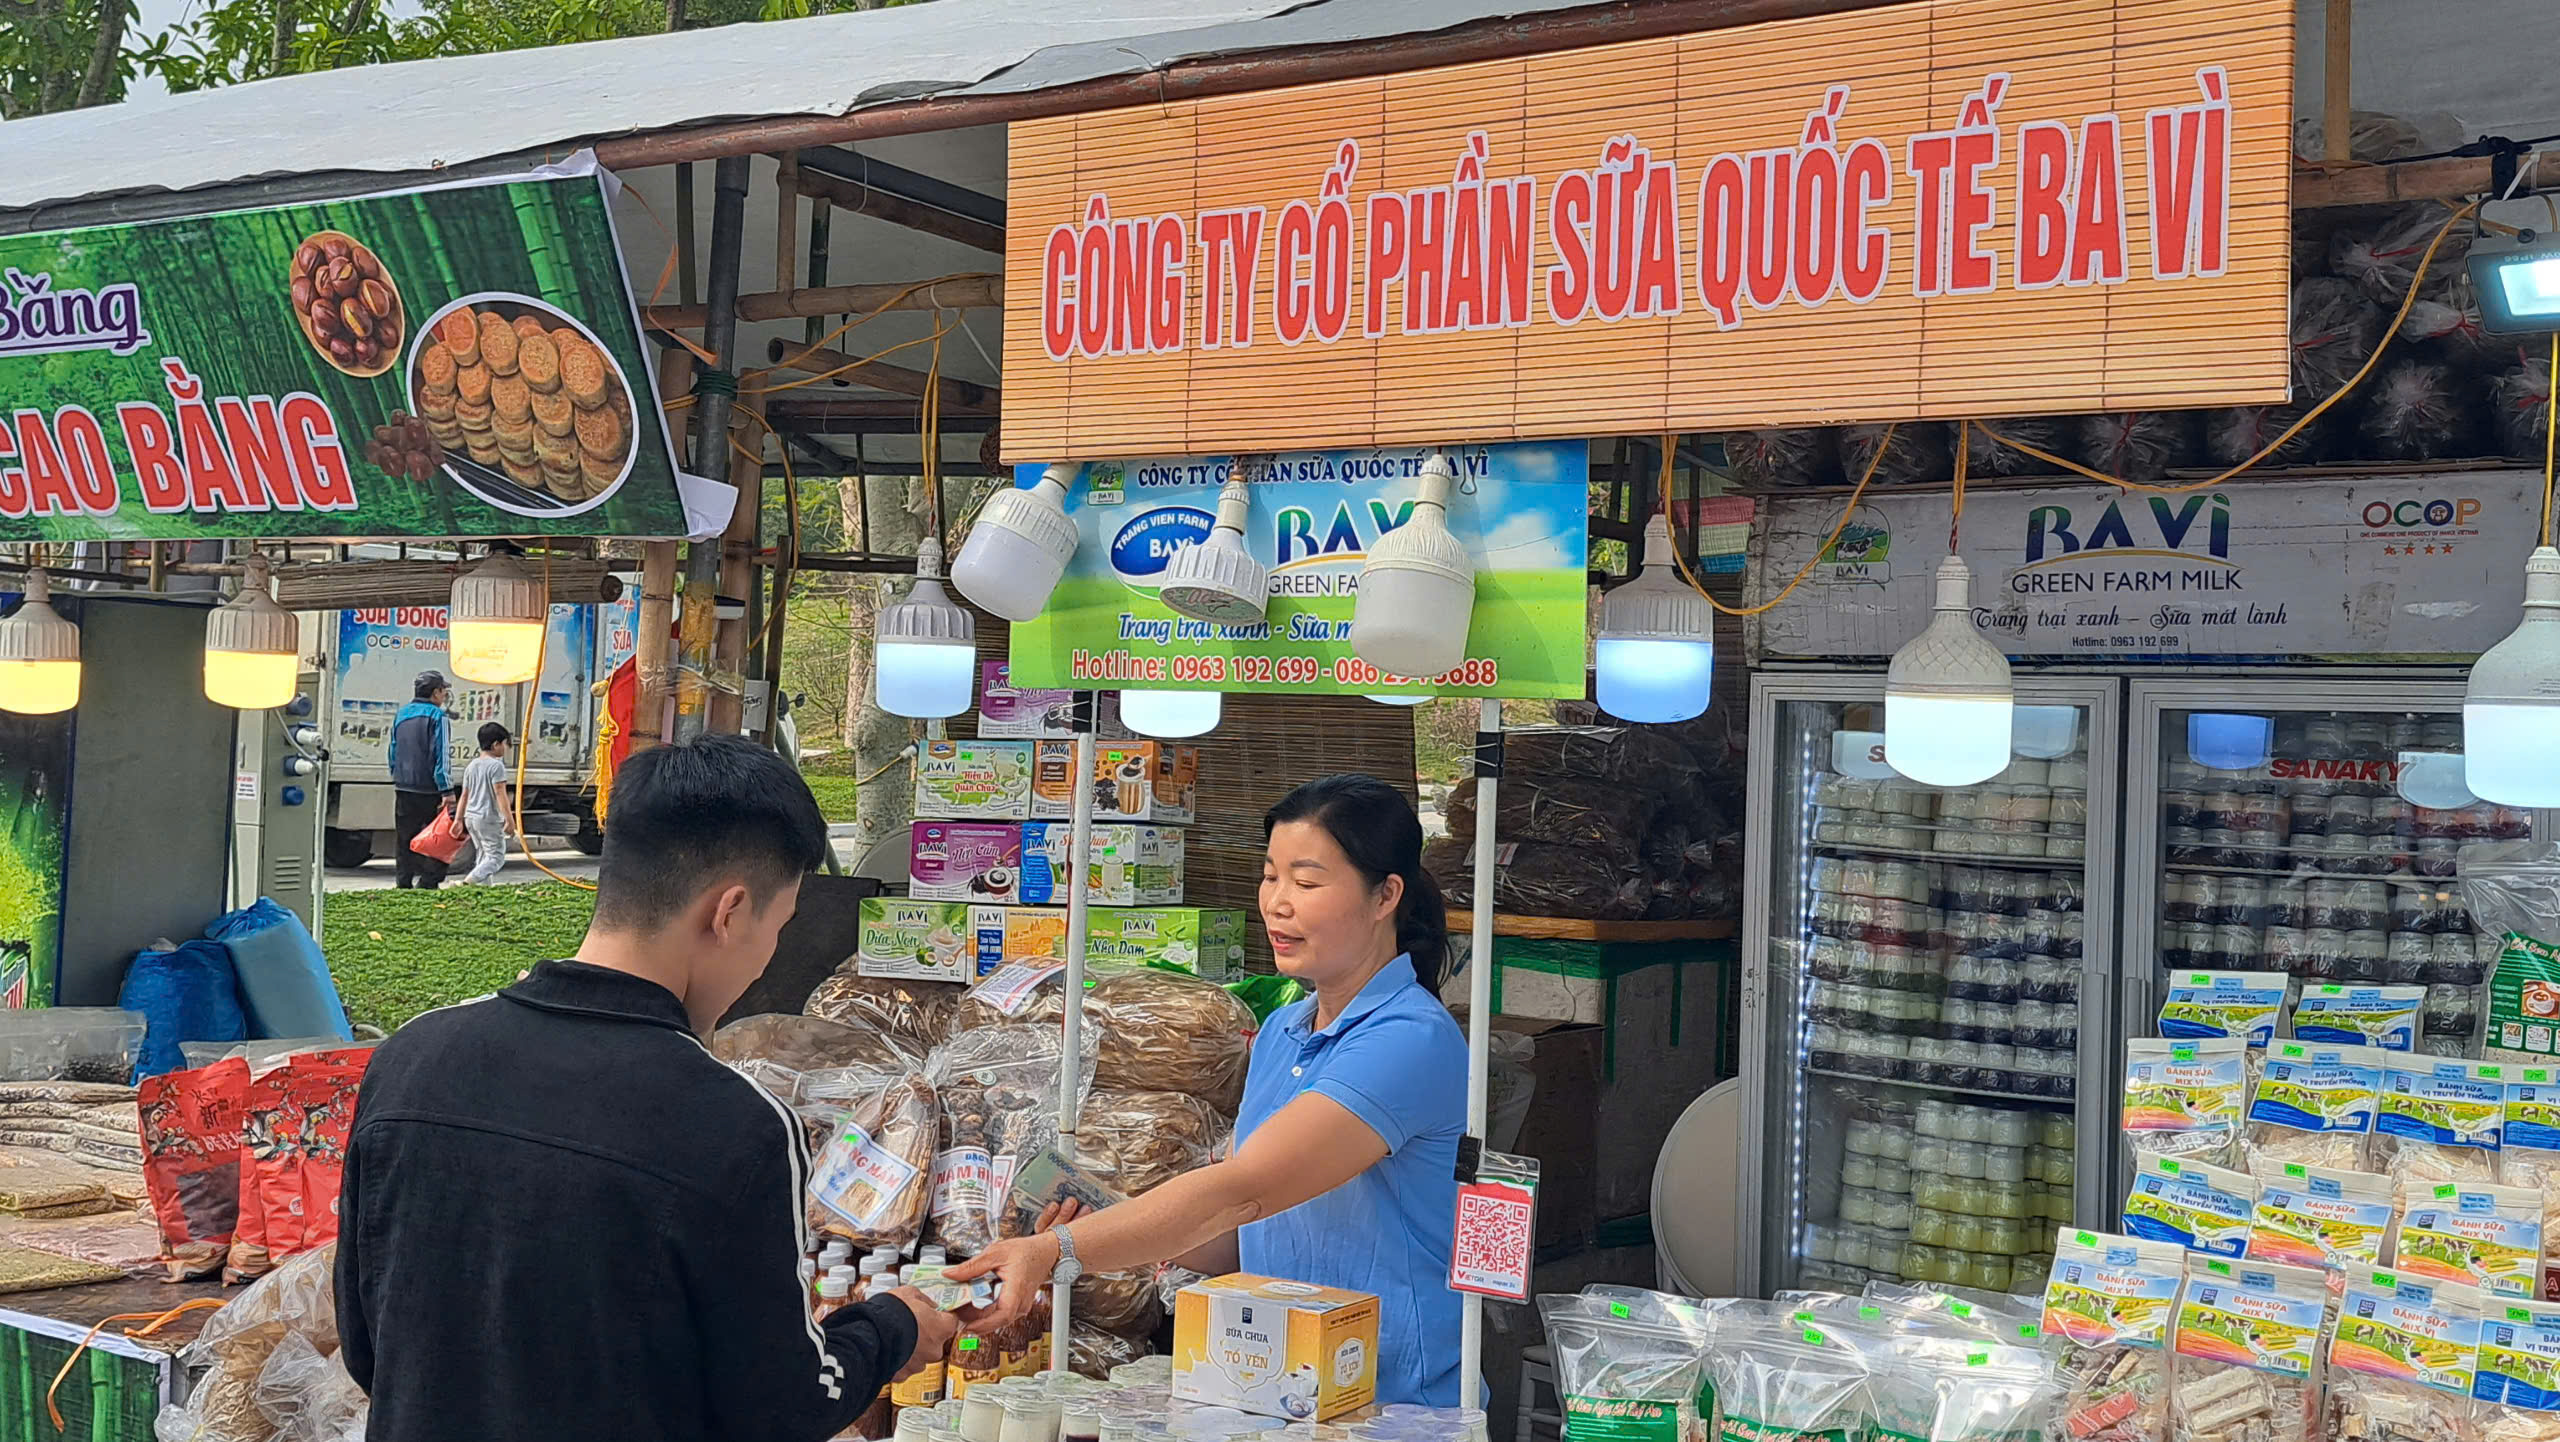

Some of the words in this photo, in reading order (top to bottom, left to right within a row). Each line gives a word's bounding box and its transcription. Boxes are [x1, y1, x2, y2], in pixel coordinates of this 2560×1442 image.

[1043, 194, 1186, 361] CÔNG
[1197, 206, 1266, 349] TY
[1275, 138, 1360, 345] CỔ
[1364, 131, 1536, 338] PHẦN
[1547, 133, 1682, 326] SỮA
[1701, 86, 1892, 331] QUỐC
[1908, 72, 2010, 297] TẾ
[2016, 114, 2127, 291] BA
[2145, 66, 2232, 280] VÌ
[0, 270, 139, 352] Bằng
[0, 404, 120, 519] CAO
[118, 357, 357, 513] BẰNG
[1138, 462, 1183, 486] CÔNG
[1187, 465, 1211, 485] TY
[1297, 455, 1336, 481] SỮA
[1341, 449, 1396, 484] QUỐC
[2363, 498, 2482, 528] OCOP
[1115, 520, 1149, 552] TRANG
[1150, 513, 1176, 527] VIEN
[1177, 513, 1210, 531] FARM
[1150, 536, 1195, 558] BAV
[1278, 501, 1416, 565] BAV
[1269, 575, 1330, 594] GREEN
[1338, 574, 1358, 593] FA
[2012, 572, 2094, 593] GREEN
[2104, 571, 2172, 592] FARM
[2182, 569, 2243, 591] MILK
[1119, 613, 1171, 645] Trang
[1289, 613, 1330, 641] Sữa
[1970, 606, 2028, 636] Trang
[2038, 607, 2067, 632] trại
[2076, 605, 2120, 627] xanh
[2150, 604, 2191, 631] Sữa
[2202, 605, 2237, 626] mát
[2248, 602, 2288, 626] lành
[2110, 636, 2135, 647] 0963
[2139, 636, 2157, 647] 192
[2160, 635, 2179, 647] 699
[1072, 650, 1166, 680] Hotline:
[1172, 656, 1226, 682] 0963
[1231, 656, 1273, 683] 192
[1277, 658, 1318, 684] 699
[2269, 757, 2411, 783] SANAKY
[1244, 1330, 1269, 1344] CHUA
[2538, 1344, 2560, 1354] TRUY
